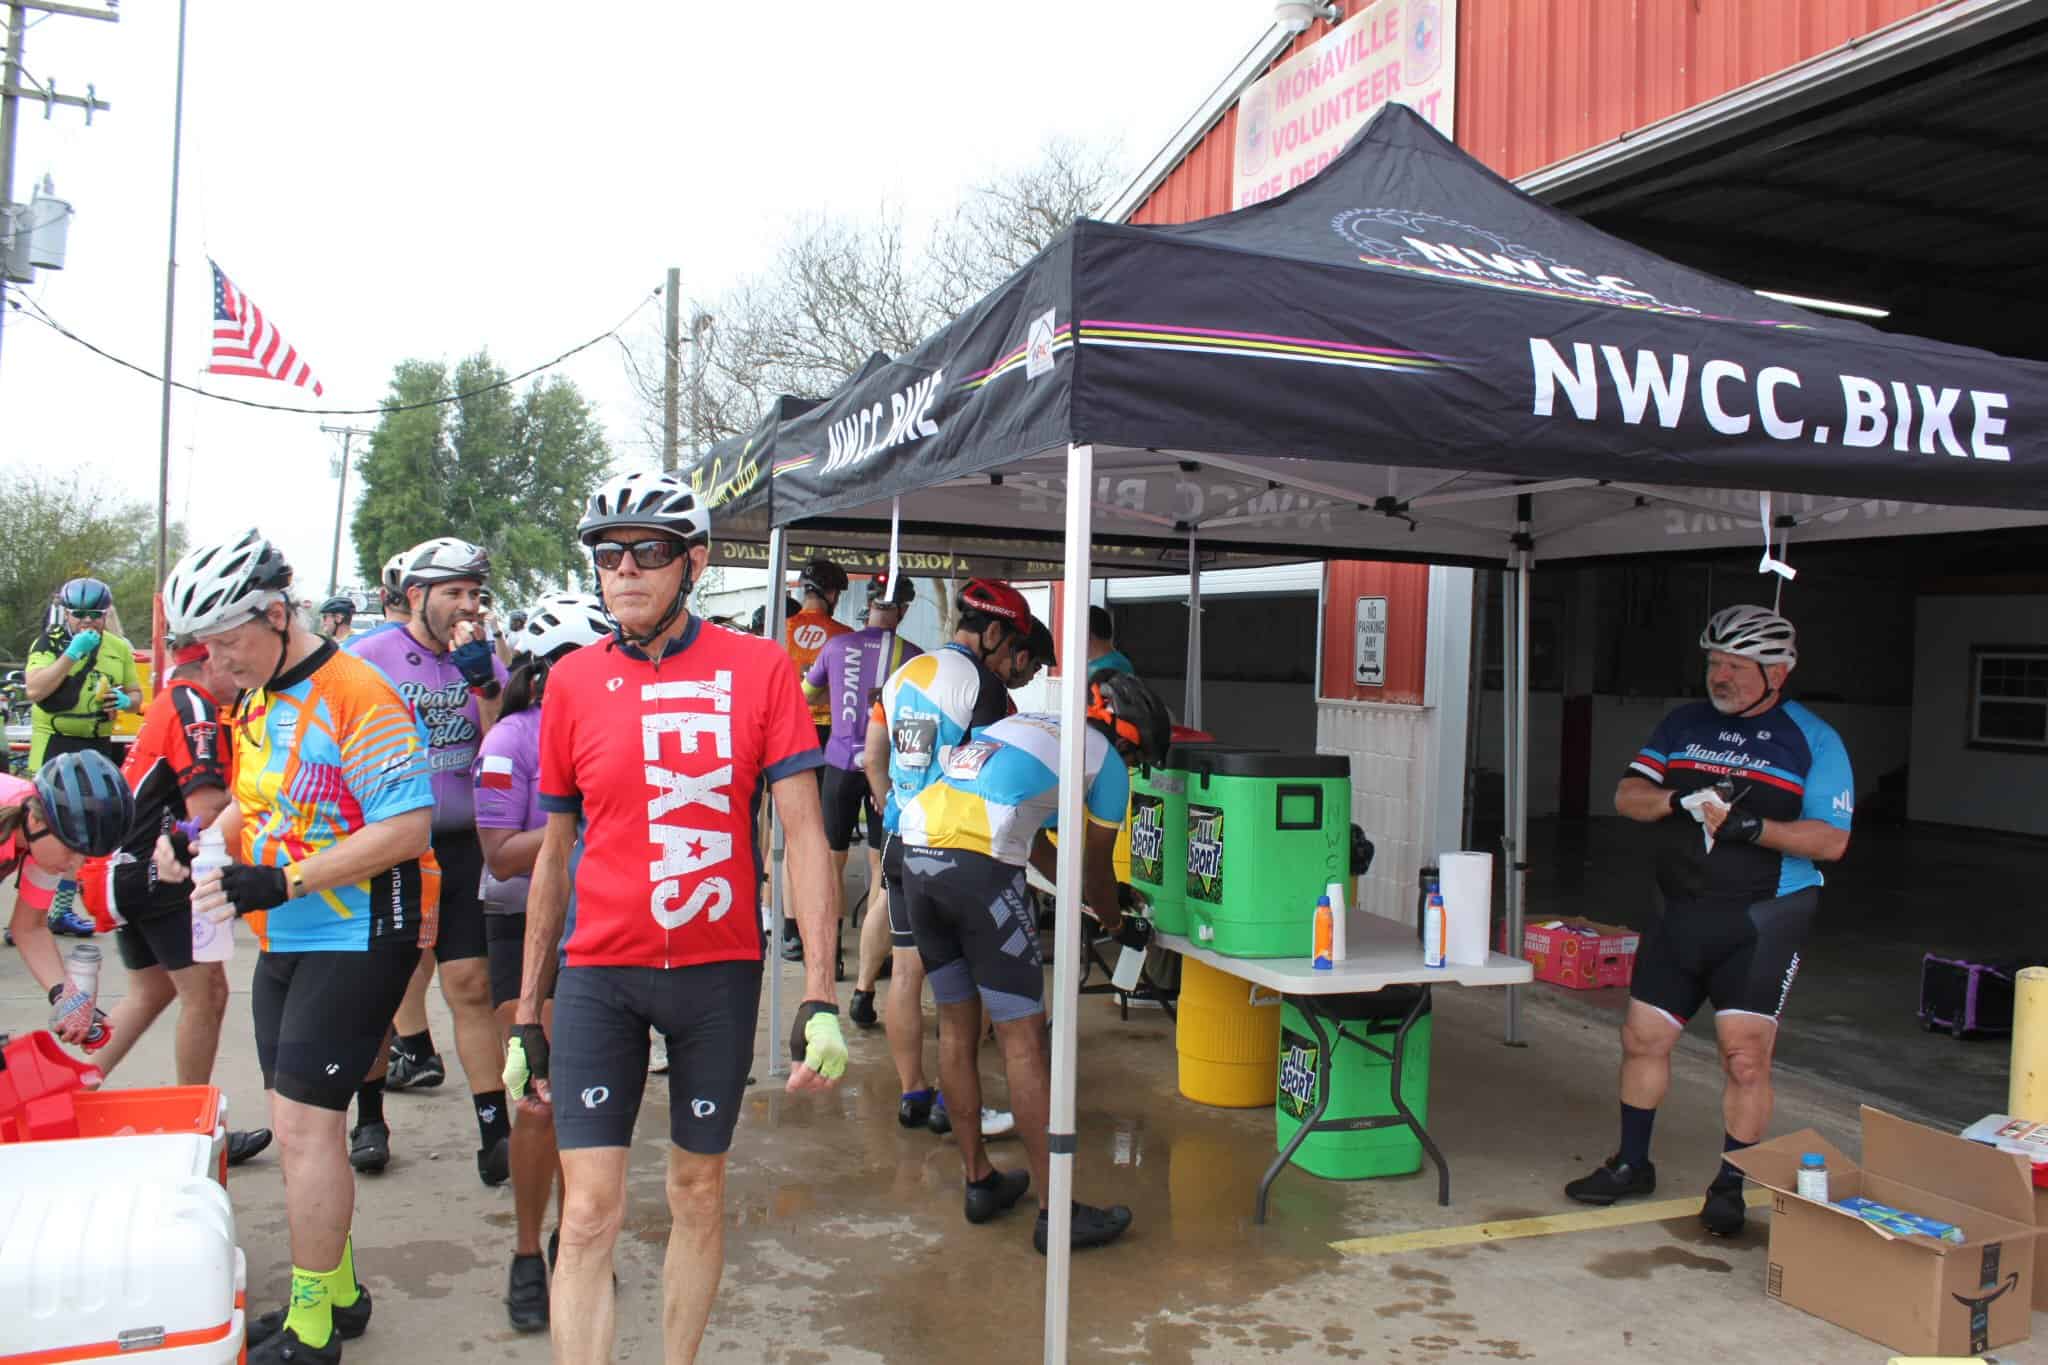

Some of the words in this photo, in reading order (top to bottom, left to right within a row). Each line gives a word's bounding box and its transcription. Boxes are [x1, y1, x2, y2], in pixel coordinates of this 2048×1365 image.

[1275, 7, 1400, 112] MONAVILLE
[1272, 61, 1402, 158] VOLUNTEER
[1529, 337, 2012, 462] NWCC.BIKE
[1358, 620, 1385, 633] PARKING
[1365, 635, 1376, 648] ANY
[399, 680, 469, 708] Heart
[842, 647, 862, 722] NWCC
[898, 729, 921, 752] 994
[1718, 731, 1747, 746] Kelly
[641, 670, 733, 929] TEXAS
[1139, 806, 1156, 832] ALL
[1196, 819, 1215, 843] ALL
[1132, 828, 1163, 861] SPORT
[1188, 841, 1223, 877] SPORT
[1289, 1045, 1308, 1075] ALL
[1280, 1059, 1315, 1103] SPORT
